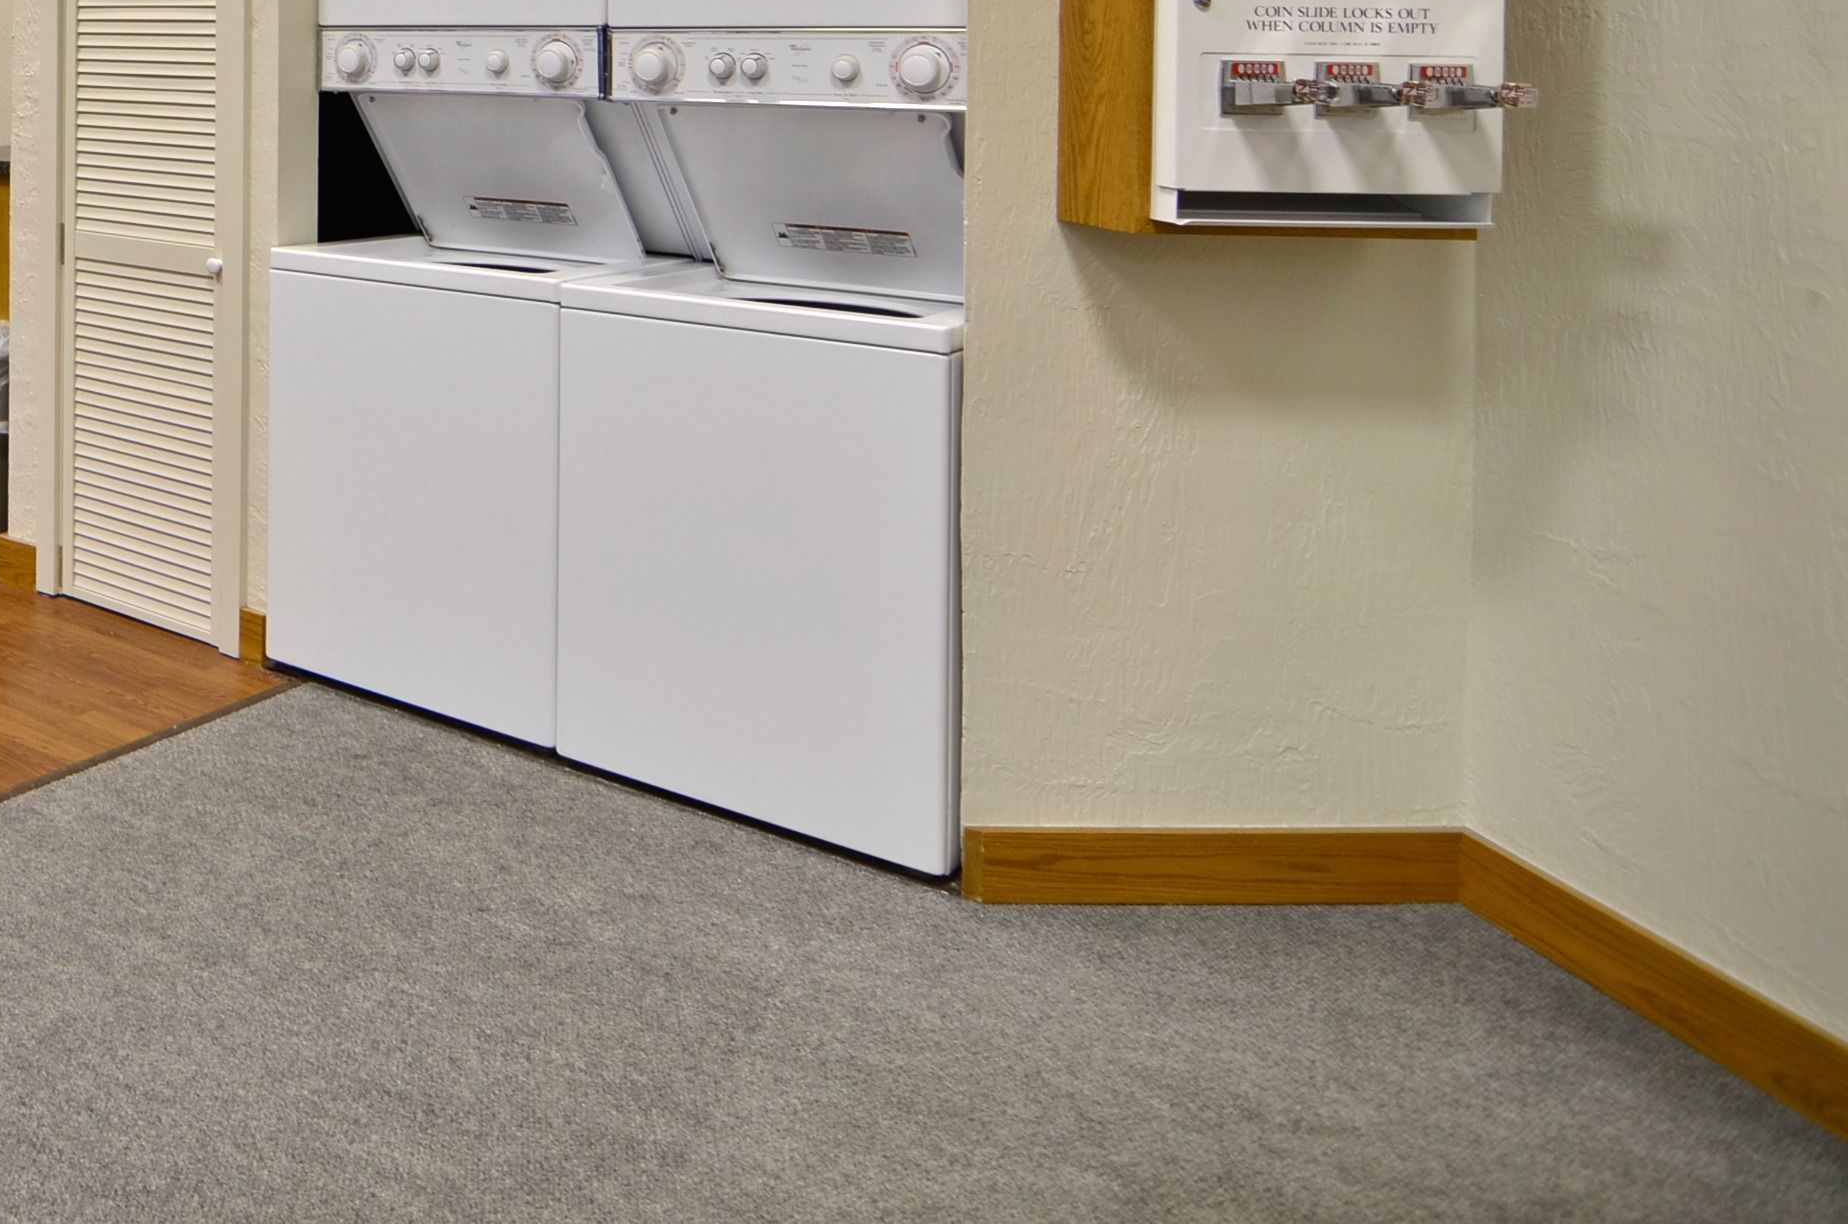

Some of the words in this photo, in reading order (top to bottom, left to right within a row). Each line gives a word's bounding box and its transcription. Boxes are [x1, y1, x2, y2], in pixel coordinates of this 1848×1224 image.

[1254, 5, 1293, 18] COIN
[1297, 6, 1338, 19] SLIDE
[1343, 7, 1393, 19] LOCKS
[1397, 8, 1431, 20] OUT
[1246, 20, 1293, 32] WHEN
[1298, 20, 1365, 33] COLUMN
[1370, 22, 1383, 33] IS
[1388, 22, 1438, 35] EMPTY
